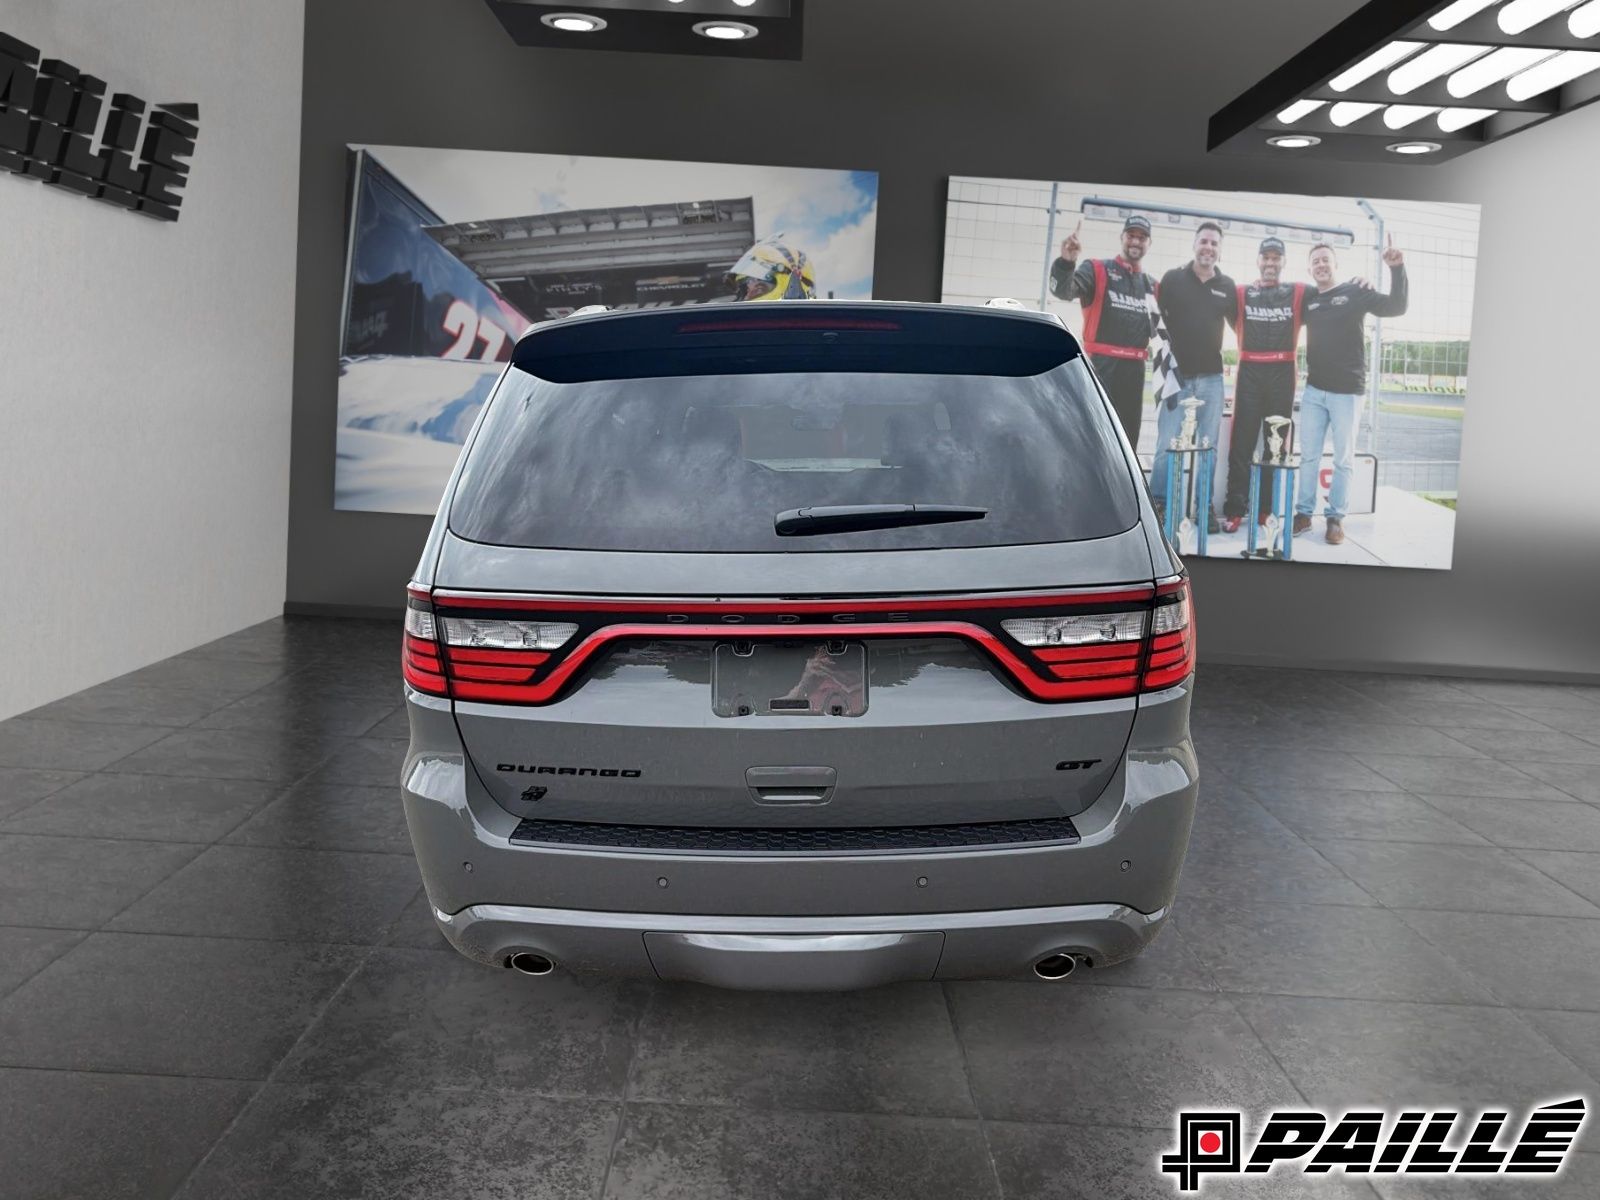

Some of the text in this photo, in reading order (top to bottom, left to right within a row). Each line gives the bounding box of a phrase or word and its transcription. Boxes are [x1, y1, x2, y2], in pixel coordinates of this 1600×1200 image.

[441, 299, 506, 364] 27
[666, 612, 910, 624] DODGE
[496, 763, 642, 778] DURANGO
[1055, 758, 1102, 771] GT
